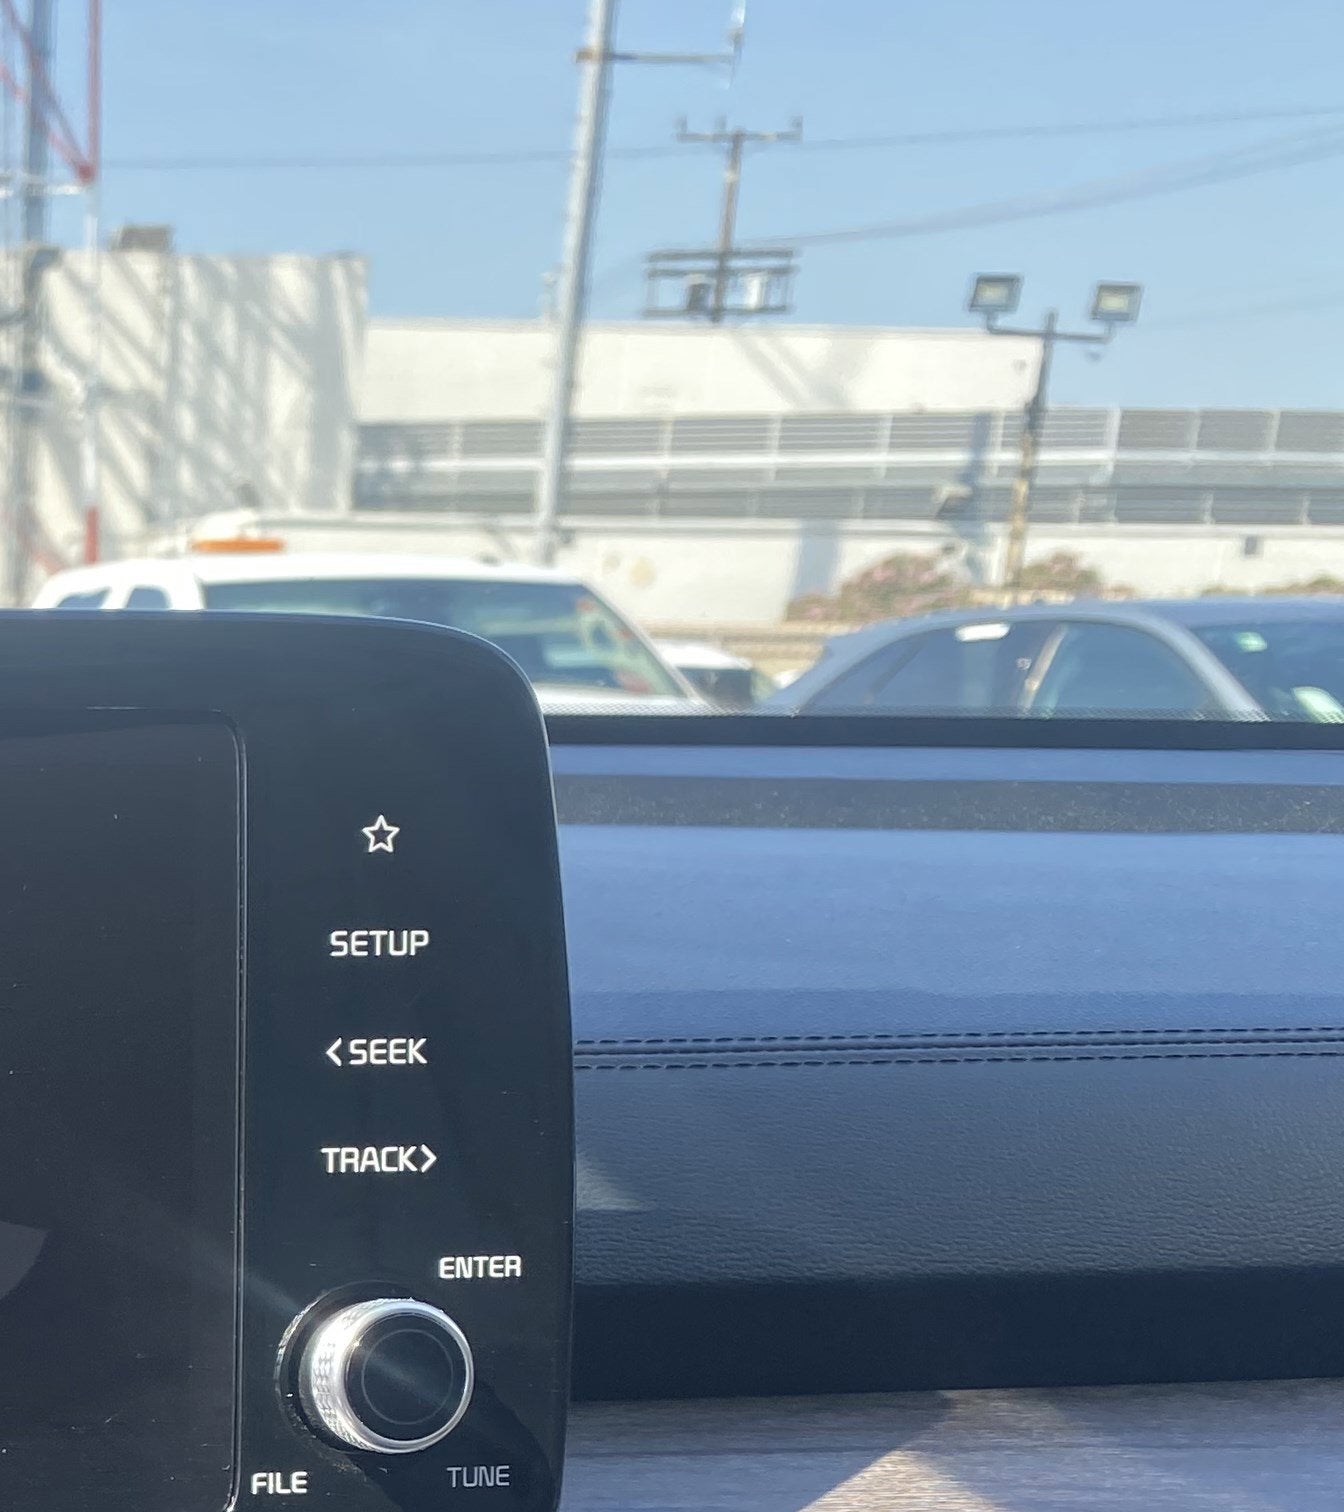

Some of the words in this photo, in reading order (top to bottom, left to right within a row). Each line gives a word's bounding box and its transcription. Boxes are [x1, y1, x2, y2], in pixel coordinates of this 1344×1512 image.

[330, 929, 430, 957] SETUP
[438, 1255, 522, 1280] ENTER
[251, 1470, 308, 1495] FILE
[446, 1465, 510, 1488] TUNE
